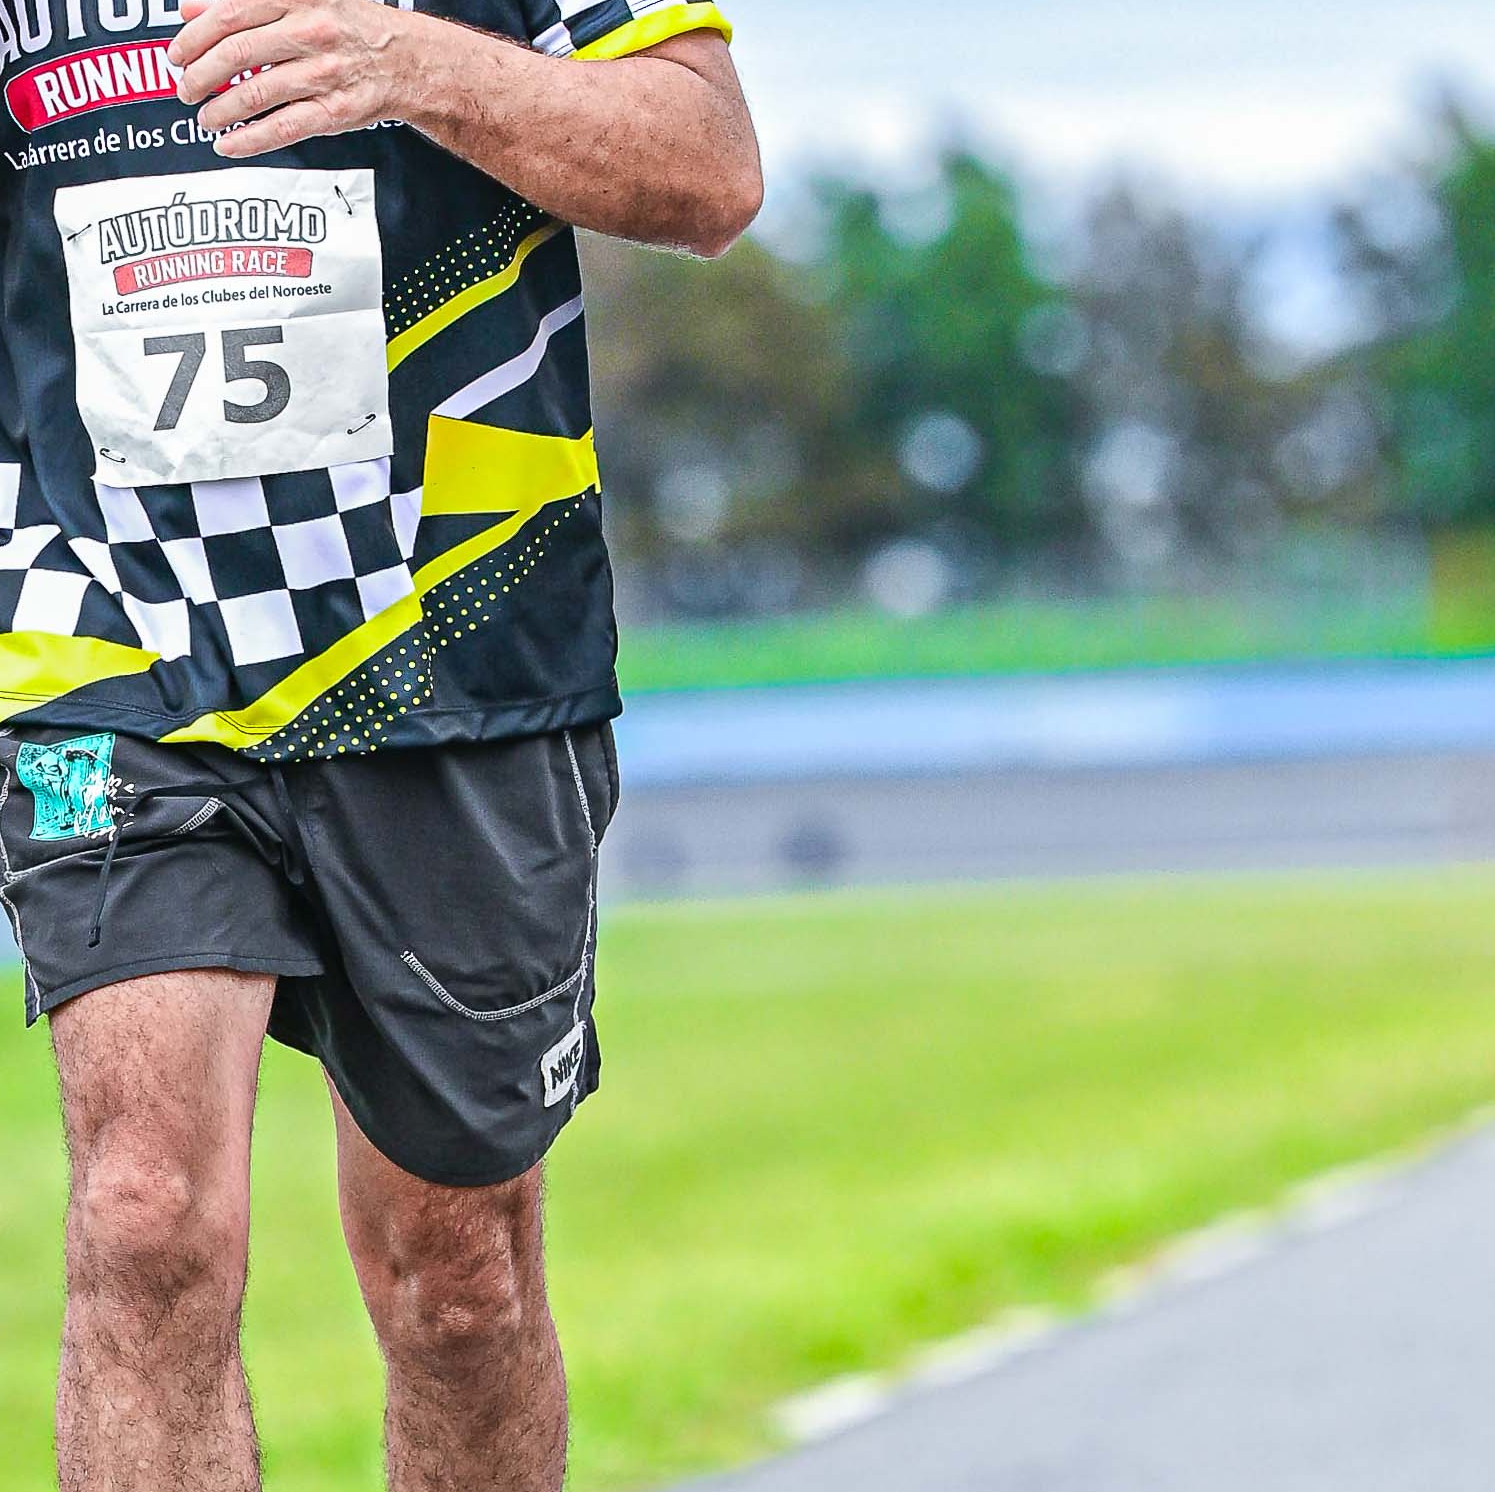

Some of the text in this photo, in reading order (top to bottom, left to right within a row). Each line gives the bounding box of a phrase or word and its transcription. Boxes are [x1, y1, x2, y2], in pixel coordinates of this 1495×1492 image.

[32, 47, 185, 118] RUNNIN
[4, 151, 29, 170] La
[30, 137, 90, 167] arrera
[94, 128, 121, 154] de
[126, 124, 165, 150] los
[99, 192, 327, 264] AUTÓDROMO
[132, 250, 289, 289] RUNNING RACE
[102, 283, 333, 315] La Carrera de los Clubes del Noroeste
[143, 325, 291, 431] 75
[549, 1038, 581, 1090] NIKE
